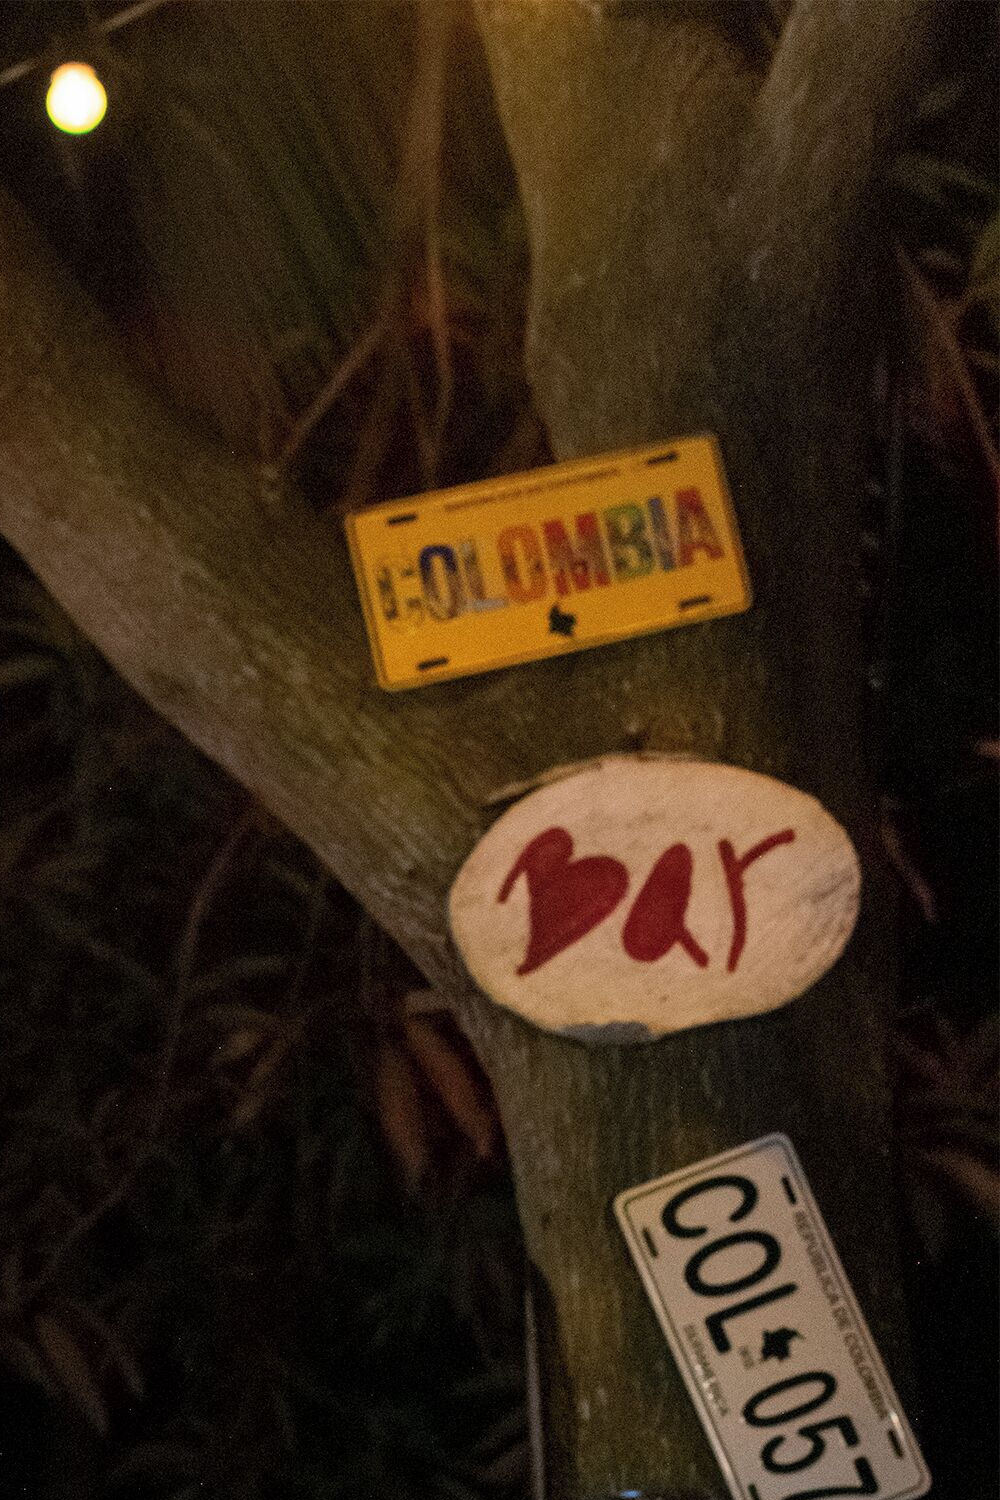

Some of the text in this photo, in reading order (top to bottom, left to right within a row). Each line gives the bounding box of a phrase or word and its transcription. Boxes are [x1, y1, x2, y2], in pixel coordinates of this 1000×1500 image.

[376, 487, 725, 624] COLOMBIA
[498, 826, 796, 977] Bar
[661, 1175, 799, 1354] COL
